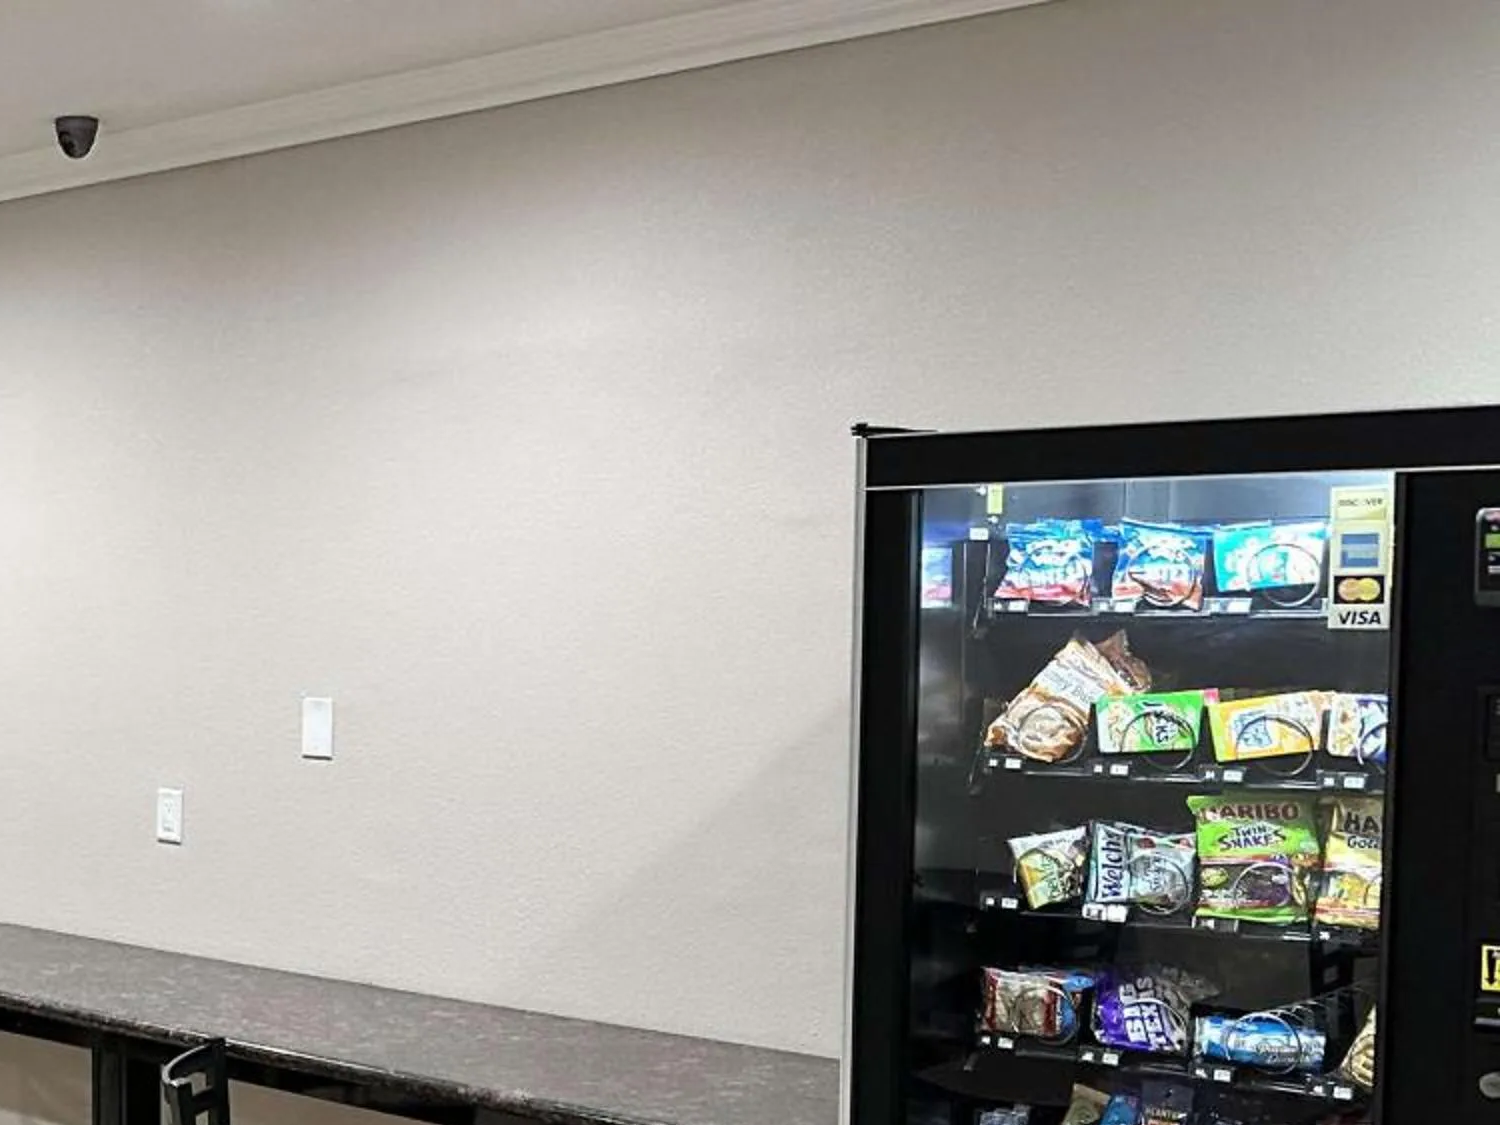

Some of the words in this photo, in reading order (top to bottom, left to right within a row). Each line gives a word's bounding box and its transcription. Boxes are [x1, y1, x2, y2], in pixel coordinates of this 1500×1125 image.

[1339, 610, 1381, 625] VISA
[1218, 830, 1288, 851] SNAKES
[1233, 825, 1267, 837] TWIN
[1102, 832, 1124, 898] Welch's
[1119, 983, 1148, 1043] BIG
[1137, 976, 1170, 1051] TEXAS
